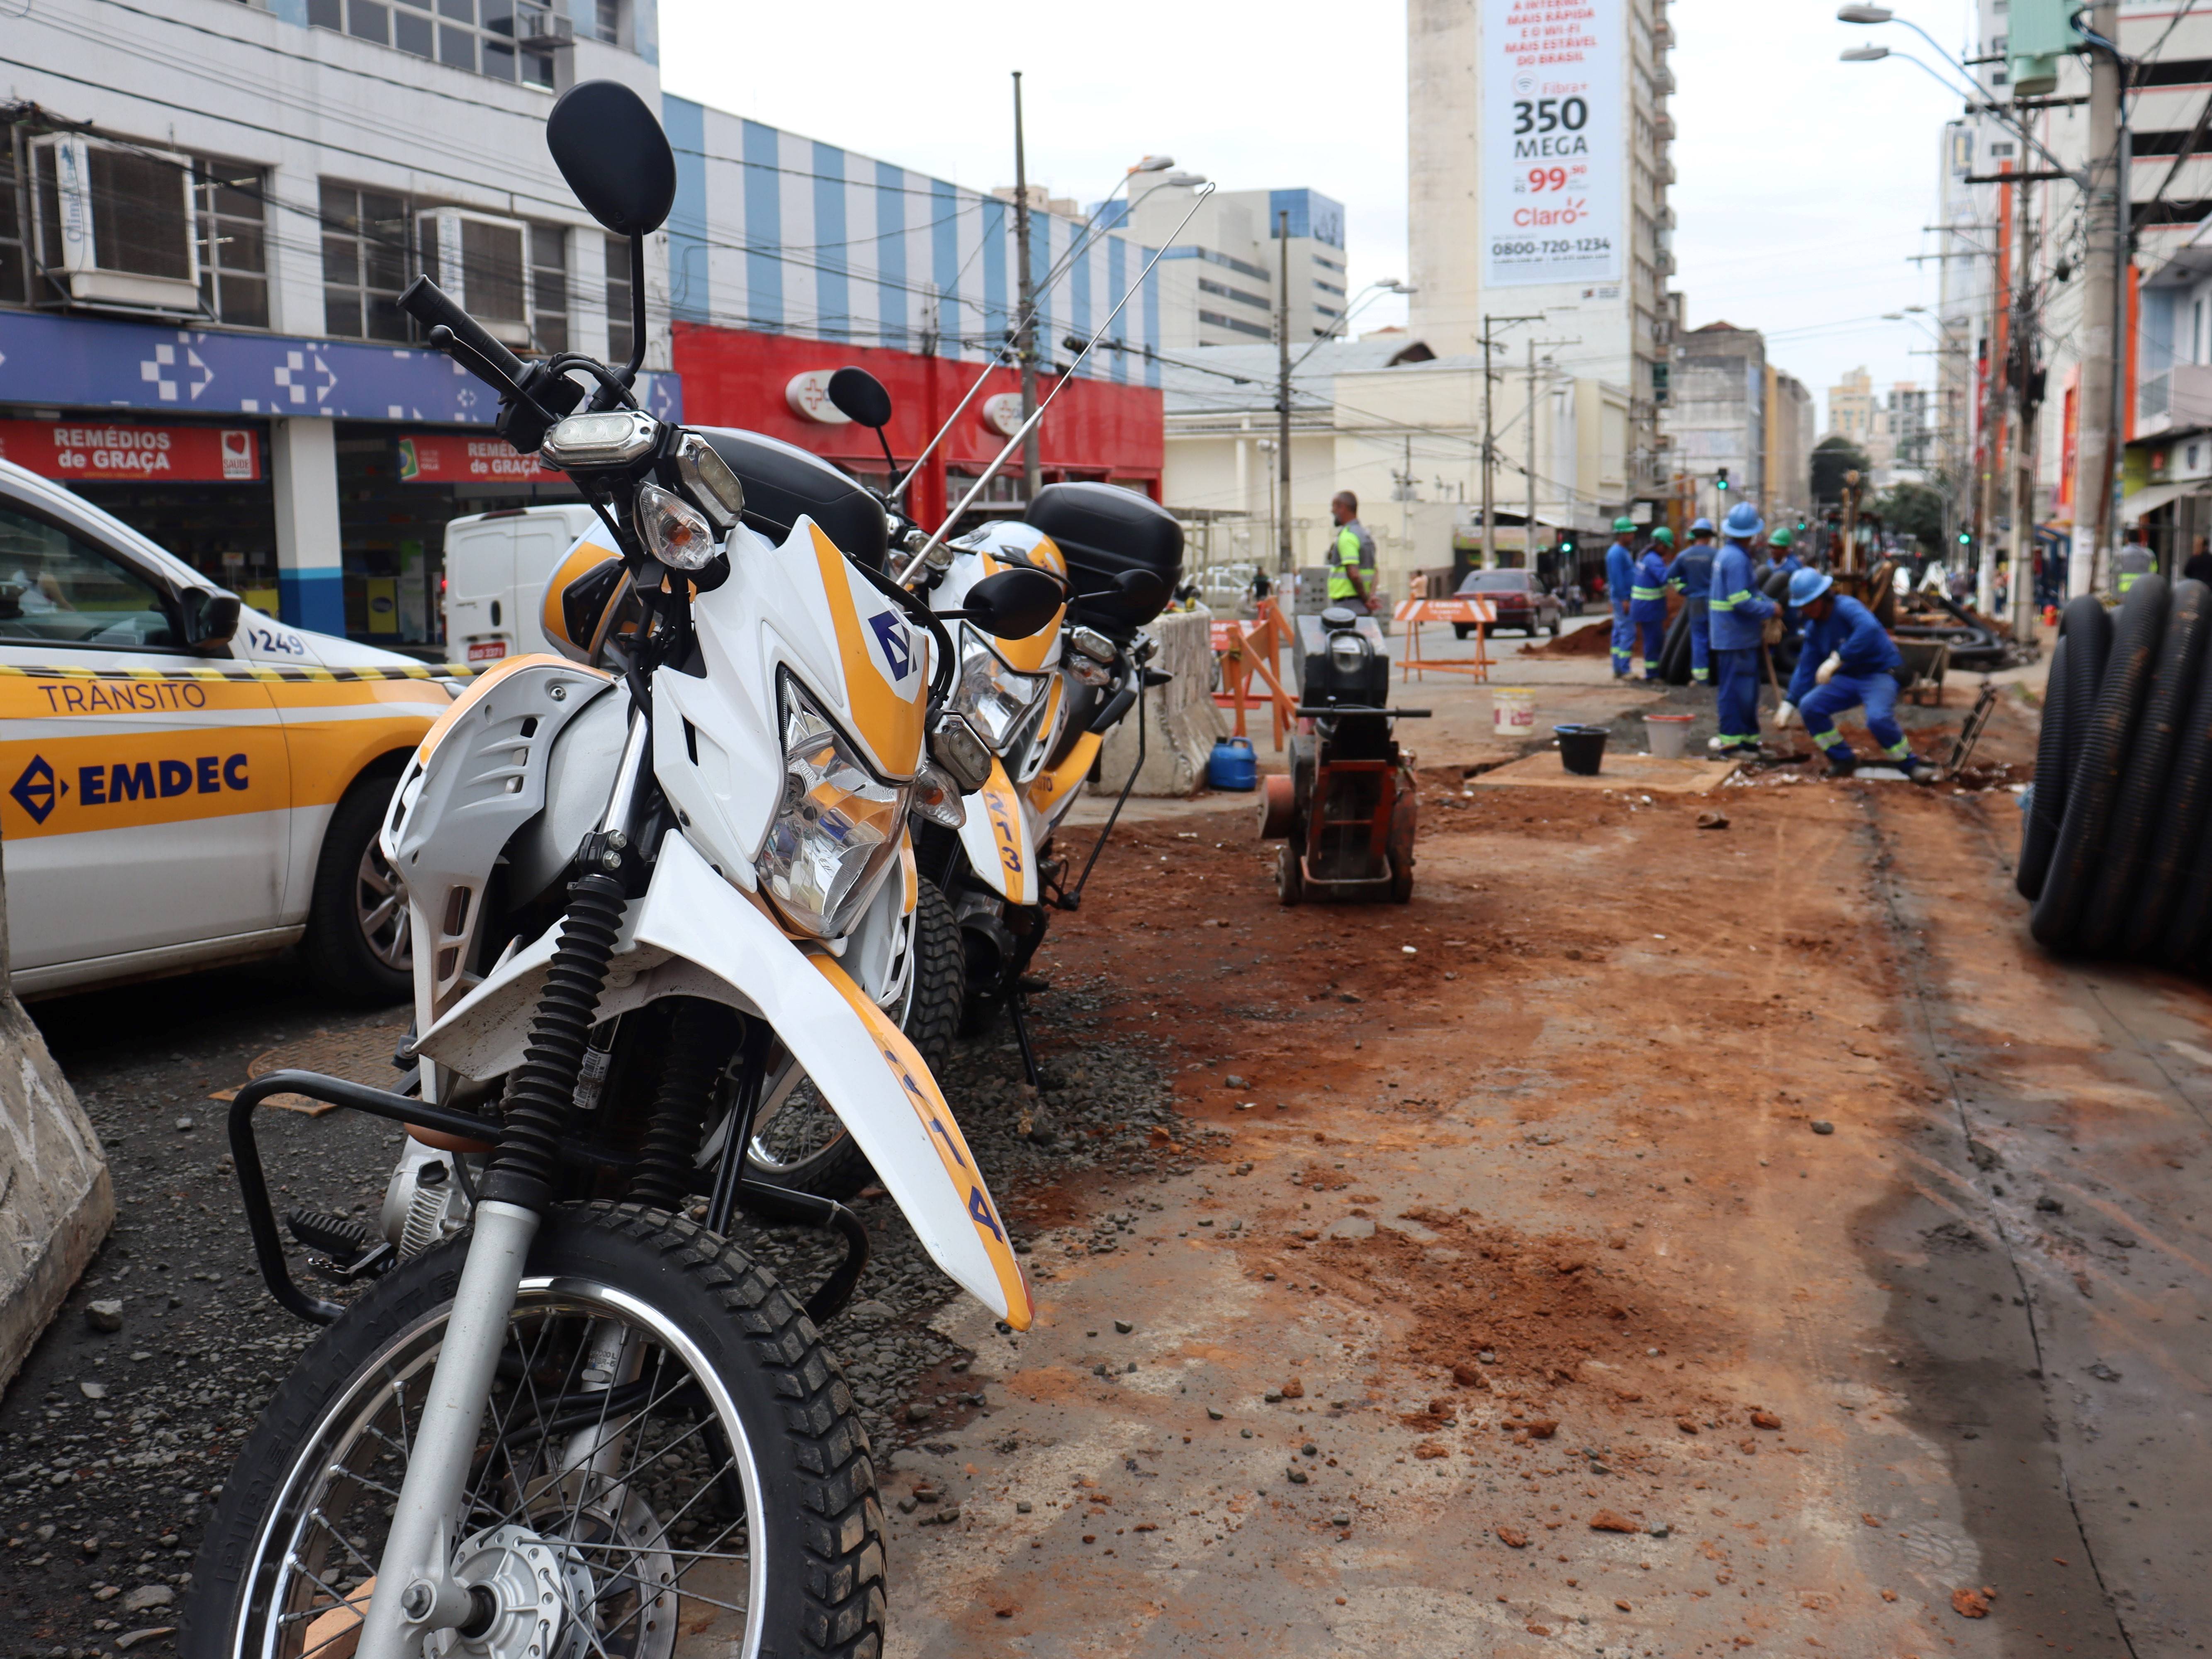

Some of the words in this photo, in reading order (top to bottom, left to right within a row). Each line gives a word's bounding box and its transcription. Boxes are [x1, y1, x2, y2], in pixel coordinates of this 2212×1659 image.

[1507, 15, 1542, 25] MAIS
[1505, 41, 1538, 53] MAIS
[1516, 55, 1535, 66] DO
[1539, 52, 1584, 64] BRASIL
[1514, 98, 1588, 134] 350
[1514, 135, 1588, 158] MEGA
[1514, 207, 1577, 226] Claro
[1492, 237, 1610, 255] 0800-720-1234
[54, 426, 170, 450] REMÉDIOS
[58, 450, 86, 468] de
[92, 450, 170, 473] GRAÇA
[470, 459, 489, 474] de
[492, 459, 541, 477] GRAÇA
[258, 629, 304, 655] 249
[38, 680, 206, 713] TRÂNSITO
[79, 753, 248, 806] EMDEC
[215, 1351, 357, 1581] PIRELLI
